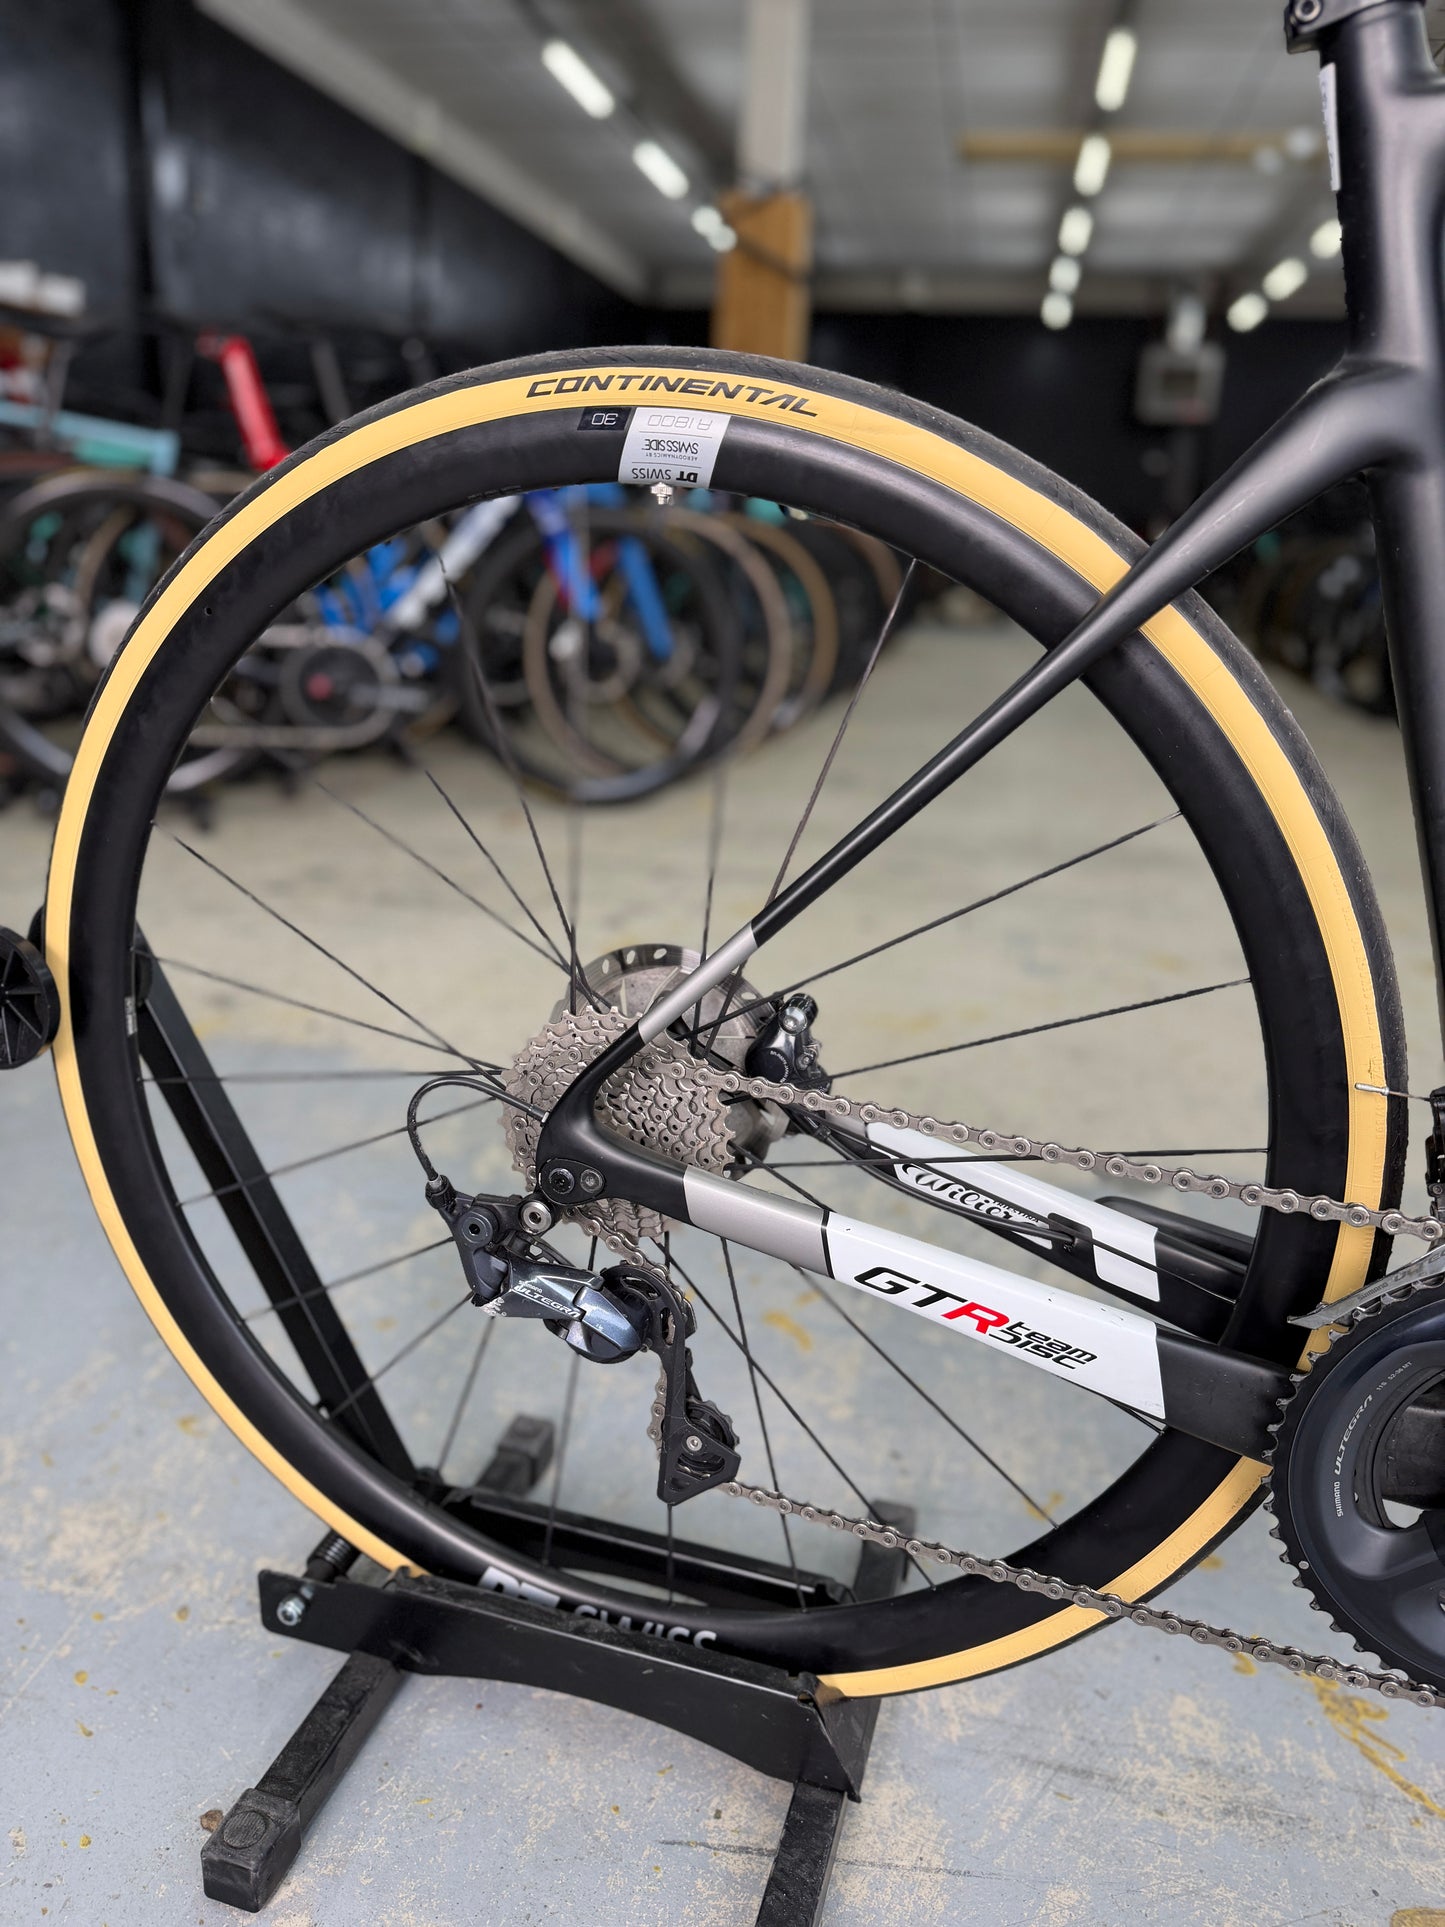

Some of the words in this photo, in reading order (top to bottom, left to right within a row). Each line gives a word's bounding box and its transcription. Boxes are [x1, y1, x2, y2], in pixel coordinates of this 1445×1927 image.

[526, 374, 818, 417] CONTINENTAL
[591, 412, 616, 426] 30
[647, 414, 694, 429] 1800
[697, 418, 713, 431] A
[654, 453, 698, 462] AERODYNAMICS
[631, 467, 672, 481] SWISS
[676, 470, 699, 483] DT
[514, 1285, 581, 1318] ULTEGRA
[854, 1266, 1010, 1335] GTR
[1005, 1321, 1098, 1363] team
[1334, 1394, 1373, 1475] ULTEGRA
[1333, 1481, 1344, 1517] SHIMANO
